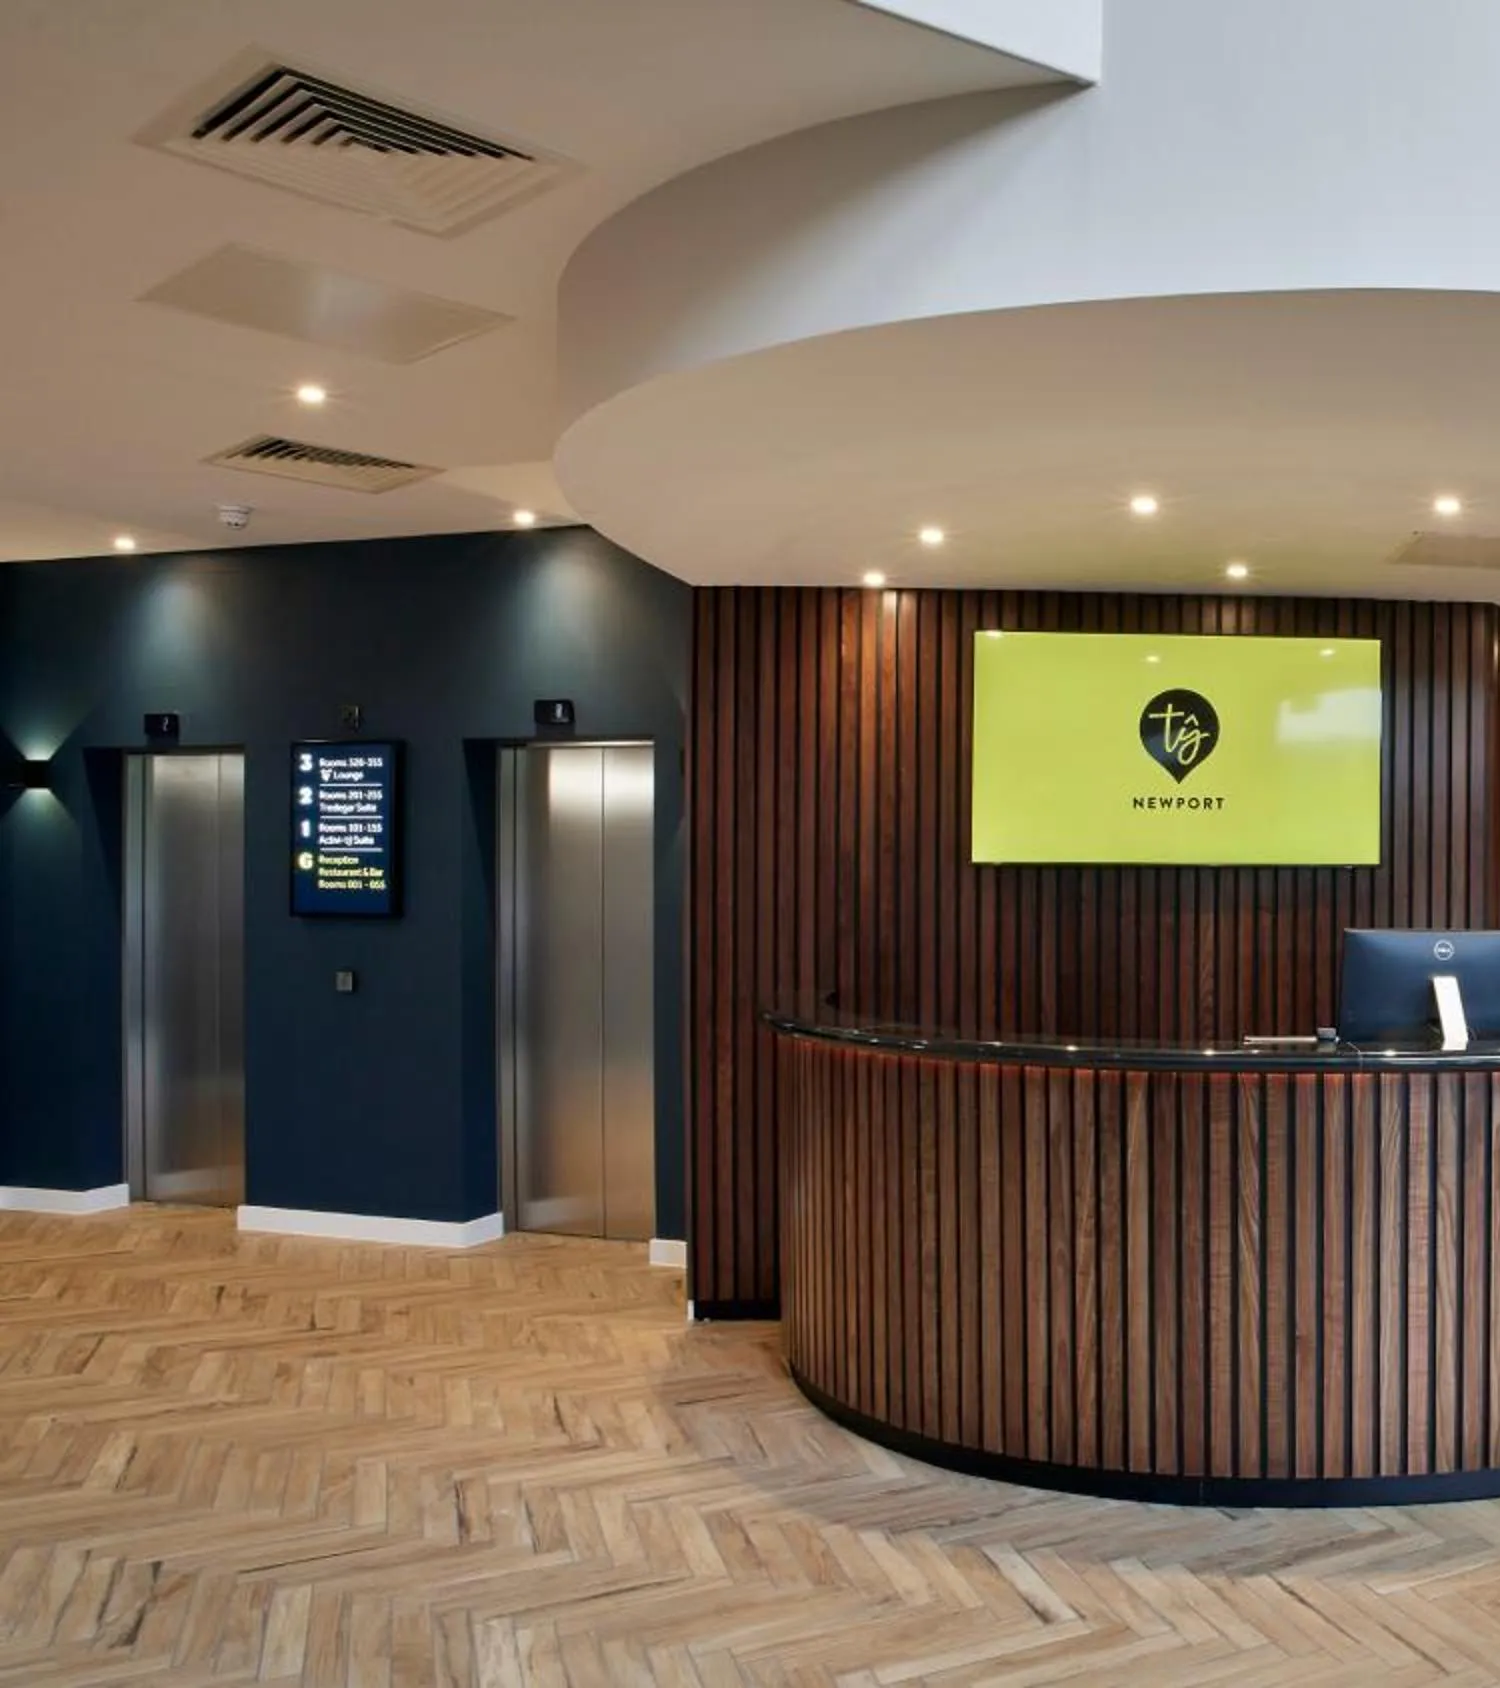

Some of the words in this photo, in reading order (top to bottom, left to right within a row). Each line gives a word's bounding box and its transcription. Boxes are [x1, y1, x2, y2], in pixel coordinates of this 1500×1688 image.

[300, 754, 313, 771] 3
[319, 757, 347, 767] Rooms
[333, 771, 364, 782] Lounge
[299, 787, 313, 805] 2
[319, 790, 347, 800] Rooms
[355, 802, 377, 812] Suite
[1133, 797, 1225, 810] NEWPORT
[301, 820, 312, 837] 1
[318, 823, 347, 833] Rooms
[353, 835, 375, 845] Suite
[318, 855, 359, 866] Reception
[318, 867, 362, 878] Restaurant
[370, 867, 384, 878] Bar
[318, 880, 347, 890] Rooms
